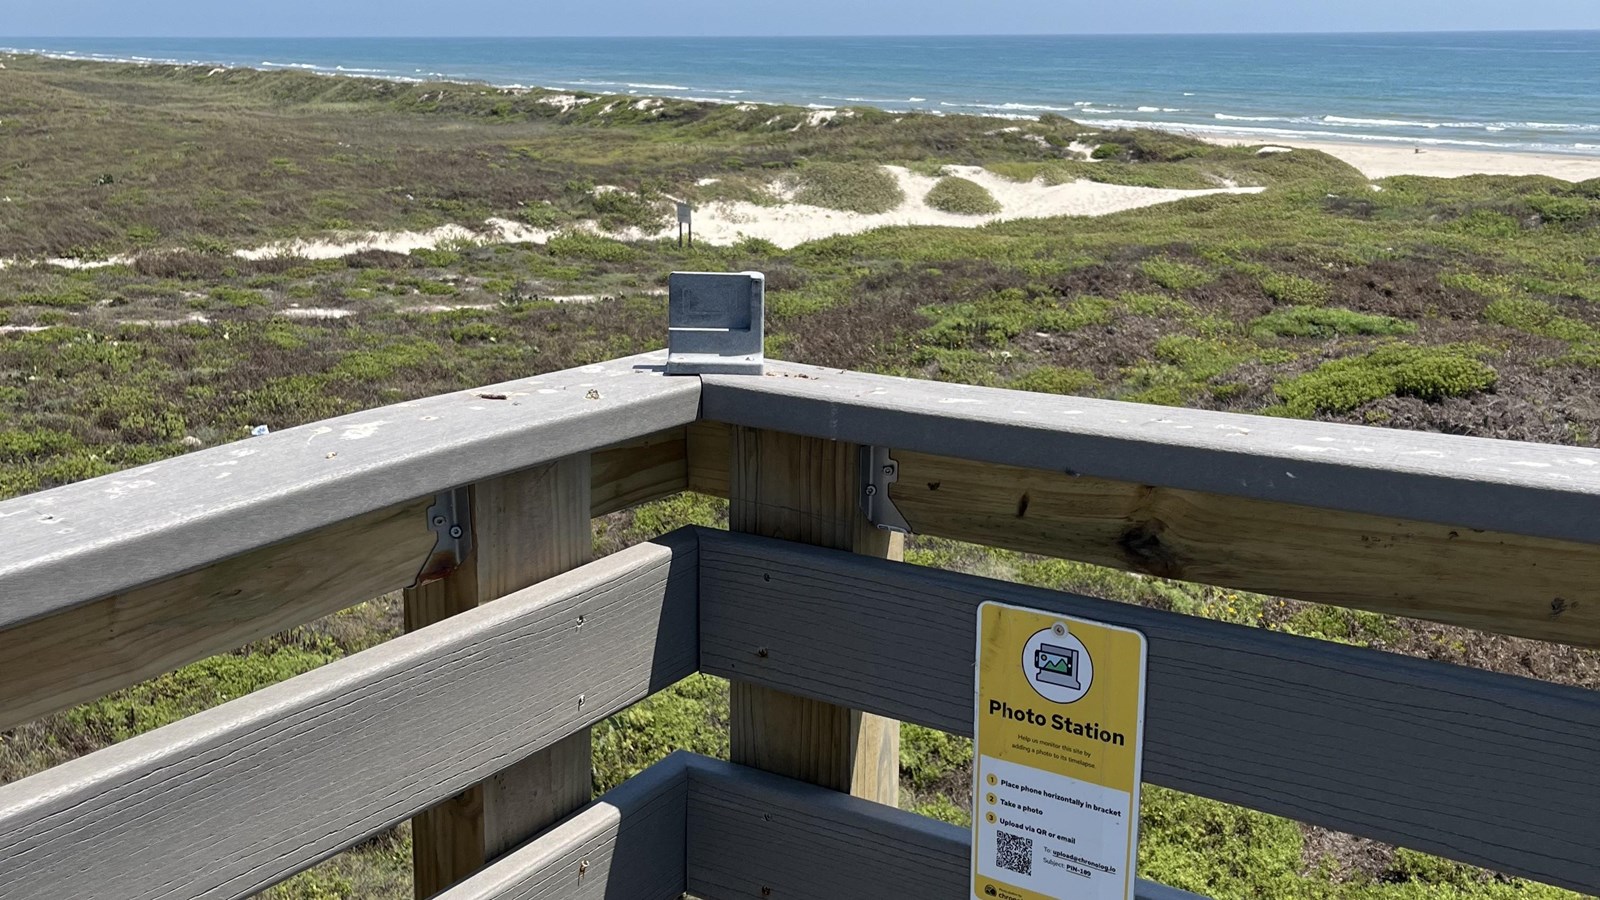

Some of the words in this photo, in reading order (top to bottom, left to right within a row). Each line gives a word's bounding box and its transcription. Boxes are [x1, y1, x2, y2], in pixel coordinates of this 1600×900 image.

[989, 699, 1046, 726] Photo
[1051, 714, 1125, 746] Station
[1012, 744, 1030, 753] adding
[1036, 749, 1052, 757] photo
[1017, 734, 1031, 743] Help
[1039, 740, 1060, 749] monitor
[1062, 744, 1072, 752] this
[1083, 750, 1091, 758] by
[1000, 779, 1019, 790] Place
[1020, 784, 1042, 795] phone
[1043, 789, 1084, 808] horizontally
[1085, 801, 1092, 809] in
[1093, 803, 1121, 817] bracket
[1000, 798, 1016, 809] Take
[1022, 804, 1043, 816] photo
[999, 818, 1024, 829] Upload
[1036, 828, 1047, 836] QR
[1056, 834, 1076, 844] email
[1052, 850, 1116, 873] upload@chronolog.io
